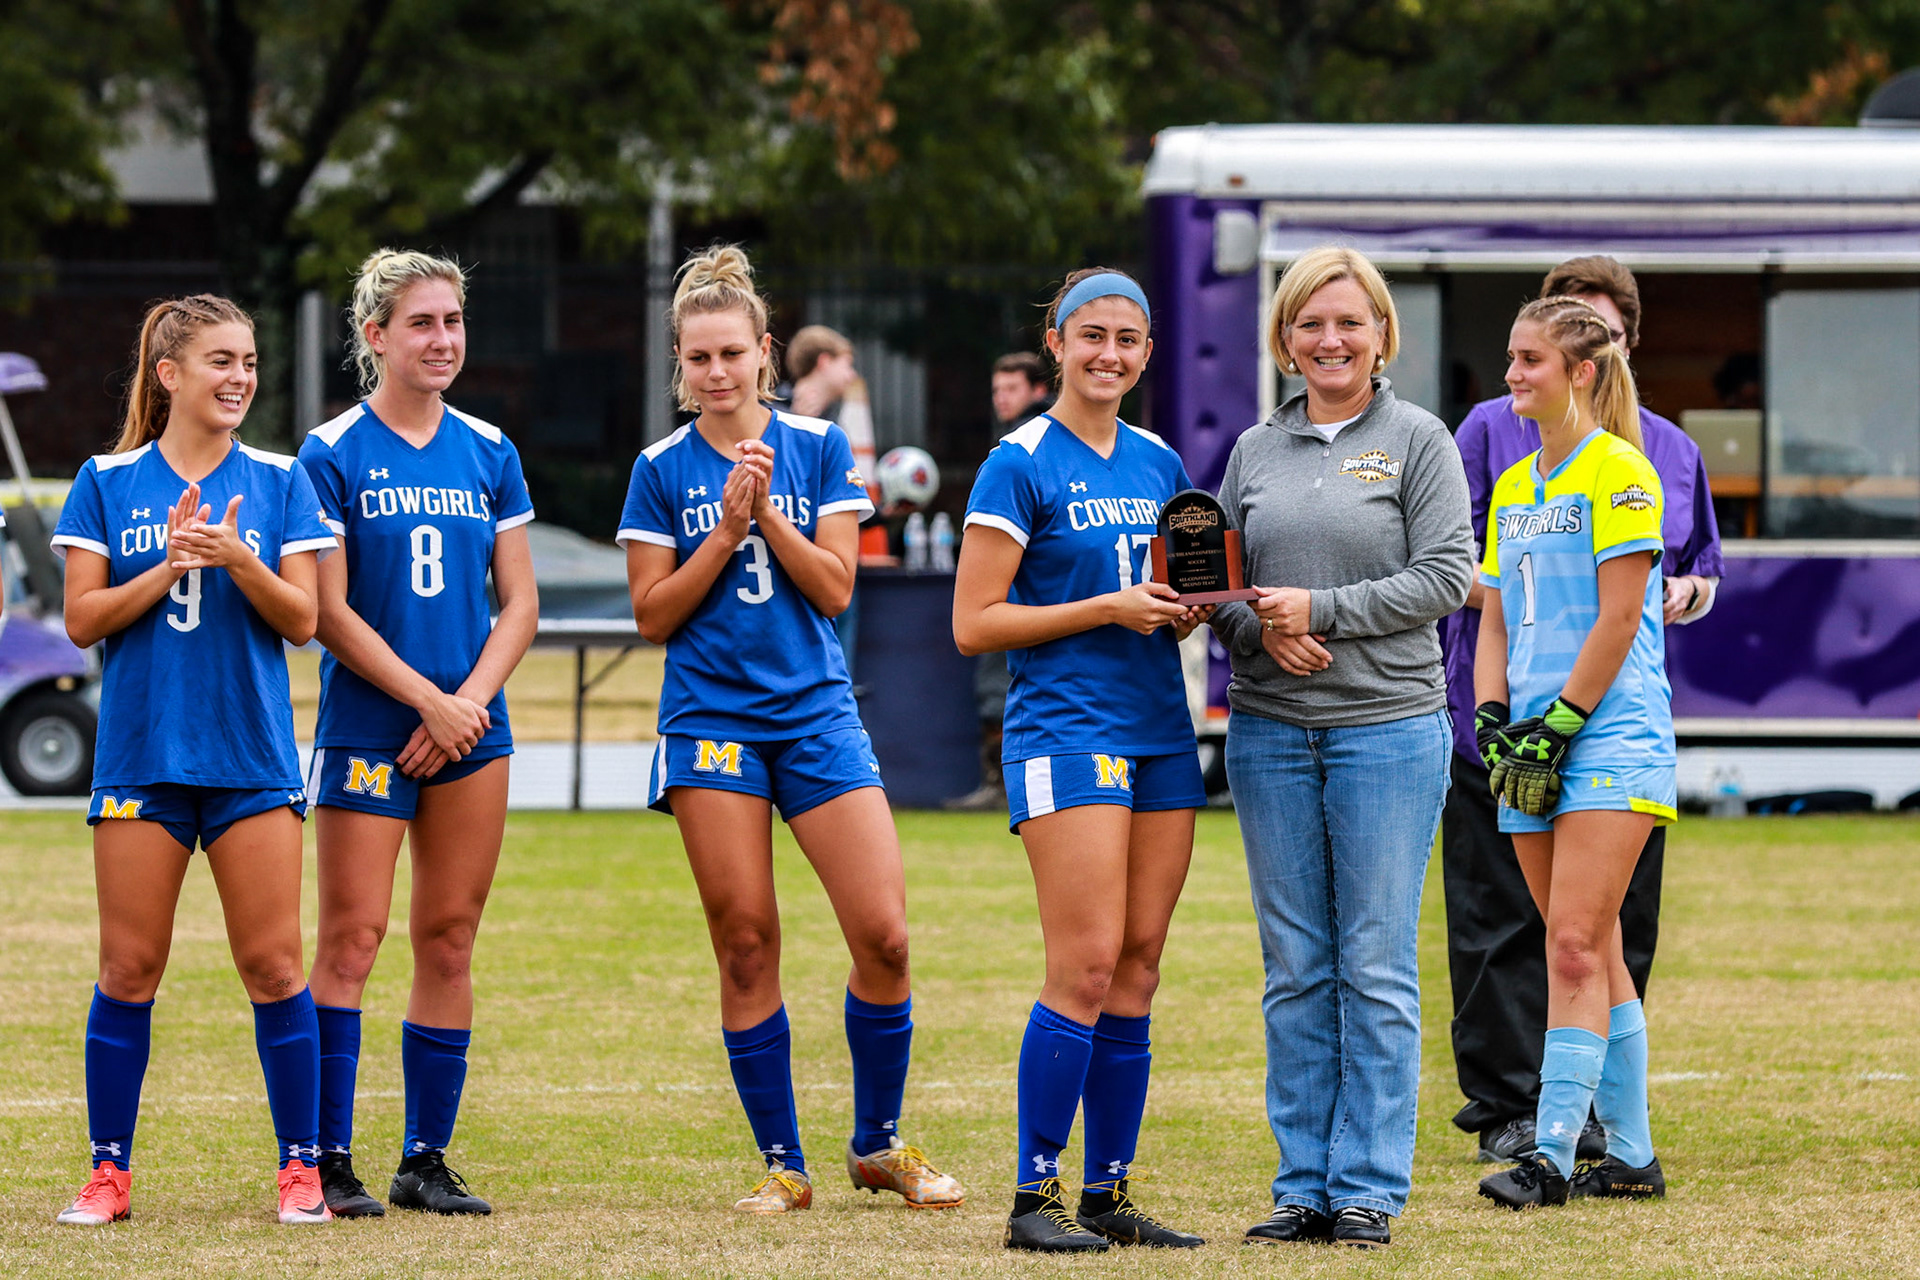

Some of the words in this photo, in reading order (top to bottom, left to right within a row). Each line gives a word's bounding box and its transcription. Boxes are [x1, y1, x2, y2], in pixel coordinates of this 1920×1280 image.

[1341, 458, 1400, 476] SOUTHLAND
[360, 486, 490, 522] COWGIRLS
[682, 494, 811, 538] COLS
[1067, 497, 1165, 531] COWGIRL
[1611, 490, 1656, 508] SOUTHLAND
[1170, 512, 1217, 528] SOUTHLAND
[1496, 505, 1582, 545] WGIRLS
[121, 523, 261, 557] COWS
[410, 525, 445, 598] 8
[735, 535, 775, 605] 3
[1114, 533, 1158, 591] 17
[166, 567, 202, 632] 9
[1517, 552, 1535, 626] 1
[693, 739, 744, 777] M
[1091, 753, 1131, 791] M
[343, 756, 394, 799] M
[100, 795, 143, 819] M
